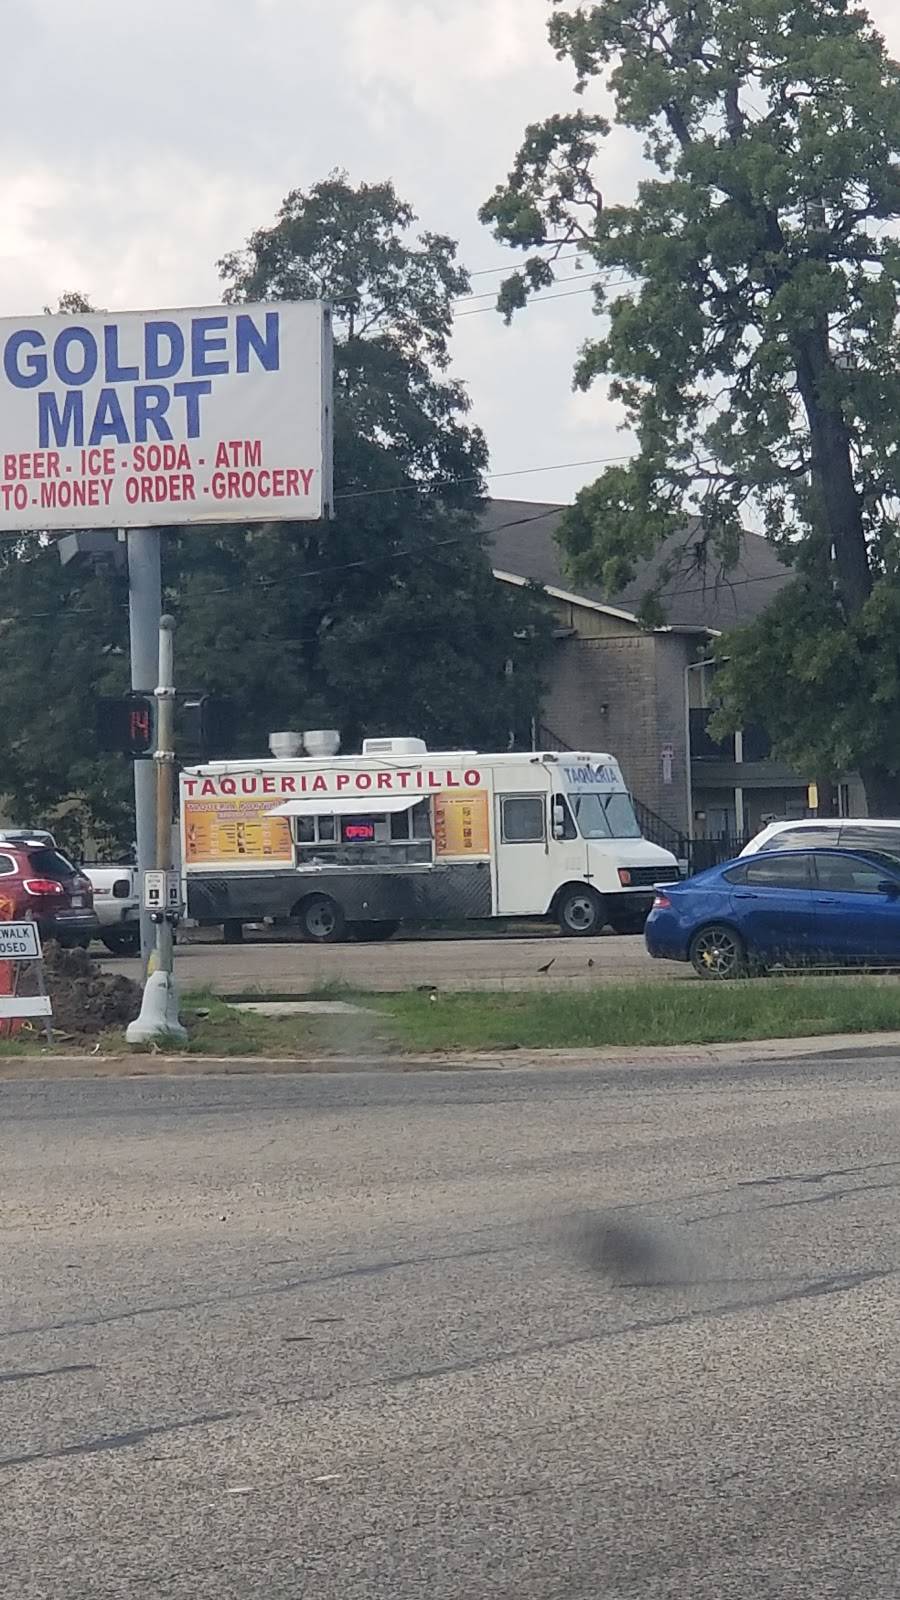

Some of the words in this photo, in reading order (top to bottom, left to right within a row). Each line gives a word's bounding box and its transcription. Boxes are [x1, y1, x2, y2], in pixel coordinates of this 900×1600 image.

[4, 312, 280, 389] GOLDEN
[38, 379, 212, 449] MART
[215, 440, 262, 468] ATM
[125, 473, 195, 504] ORDER
[184, 774, 327, 796] TAQUERIA
[336, 769, 480, 790] PORTILLO
